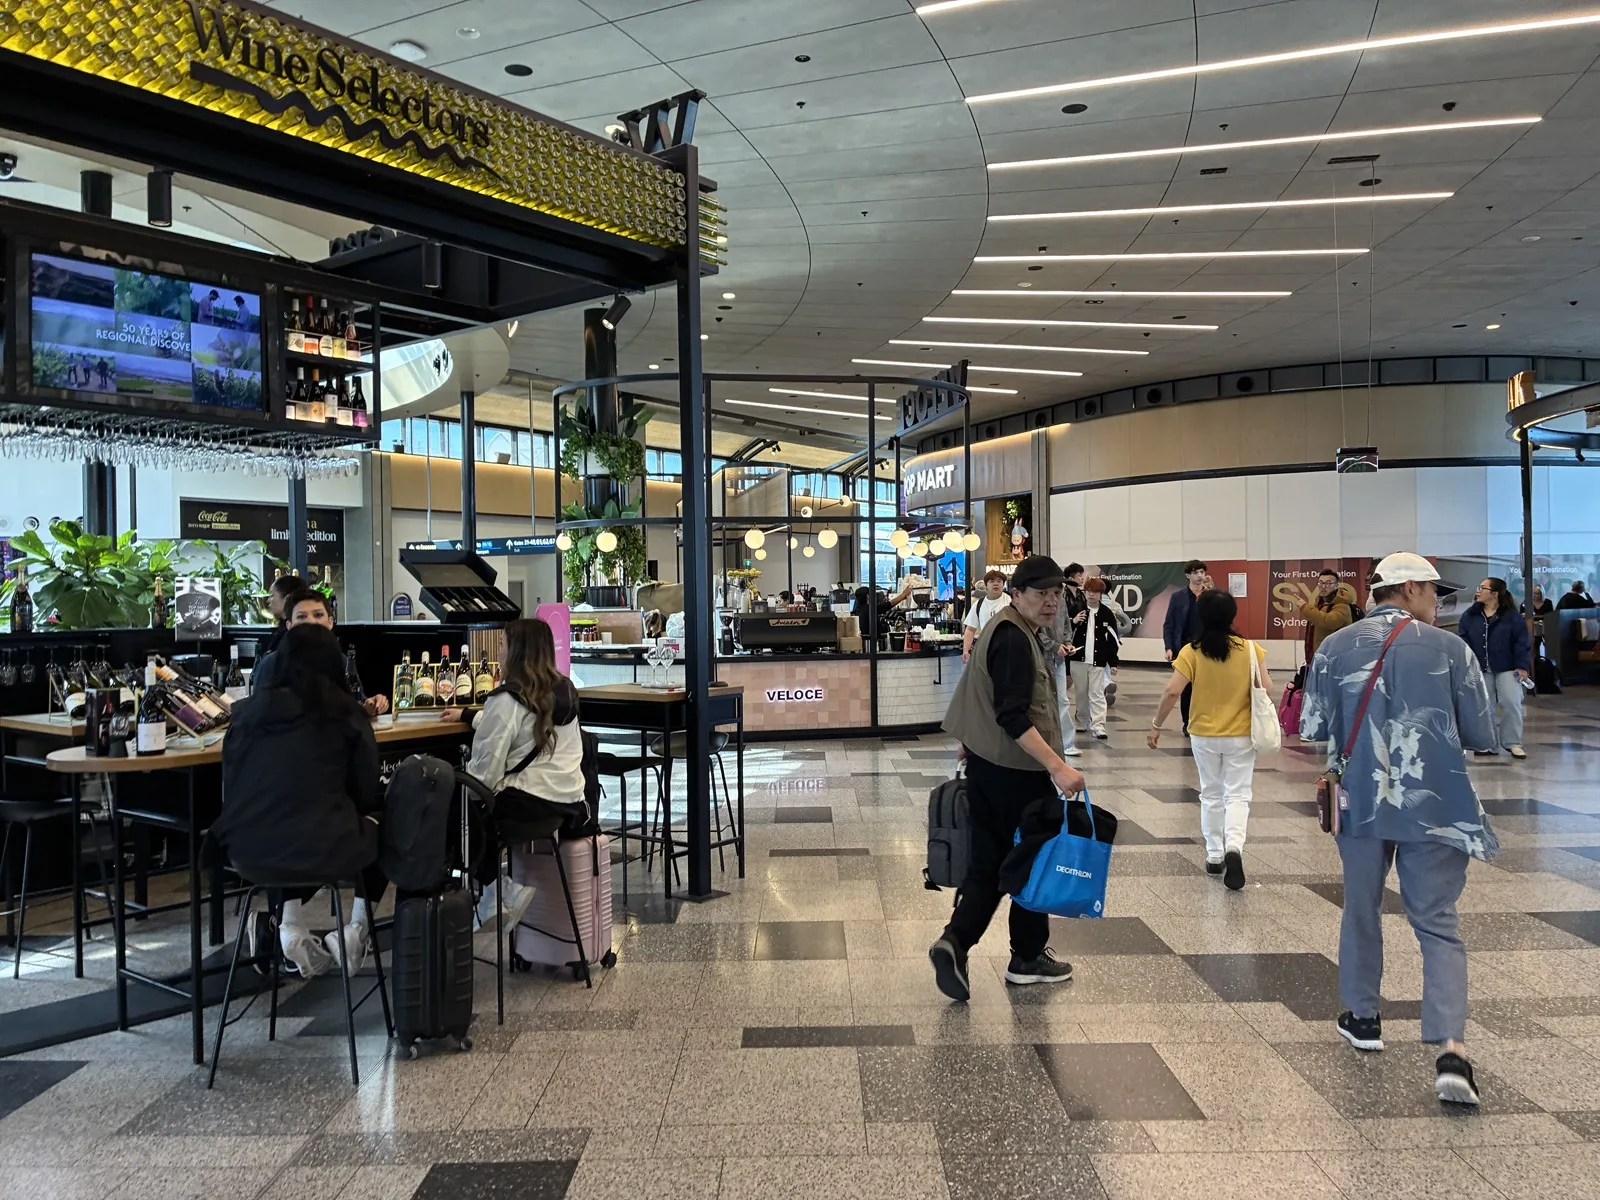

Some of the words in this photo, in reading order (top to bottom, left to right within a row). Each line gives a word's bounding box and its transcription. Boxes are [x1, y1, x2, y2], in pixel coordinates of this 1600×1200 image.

[96, 329, 148, 345] REGIONAL
[122, 323, 136, 333] 50
[139, 326, 169, 338] YEARS
[171, 331, 186, 341] OF
[917, 464, 954, 492] MART
[306, 530, 337, 542] edition
[307, 544, 317, 554] ox
[1292, 570, 1310, 578] First
[1311, 570, 1356, 578] Deation
[1107, 584, 1143, 612] YD
[1130, 616, 1143, 625] ort
[1273, 617, 1308, 628] Sydne
[767, 689, 823, 701] VELOCE
[1055, 865, 1092, 879] DECATHLON
